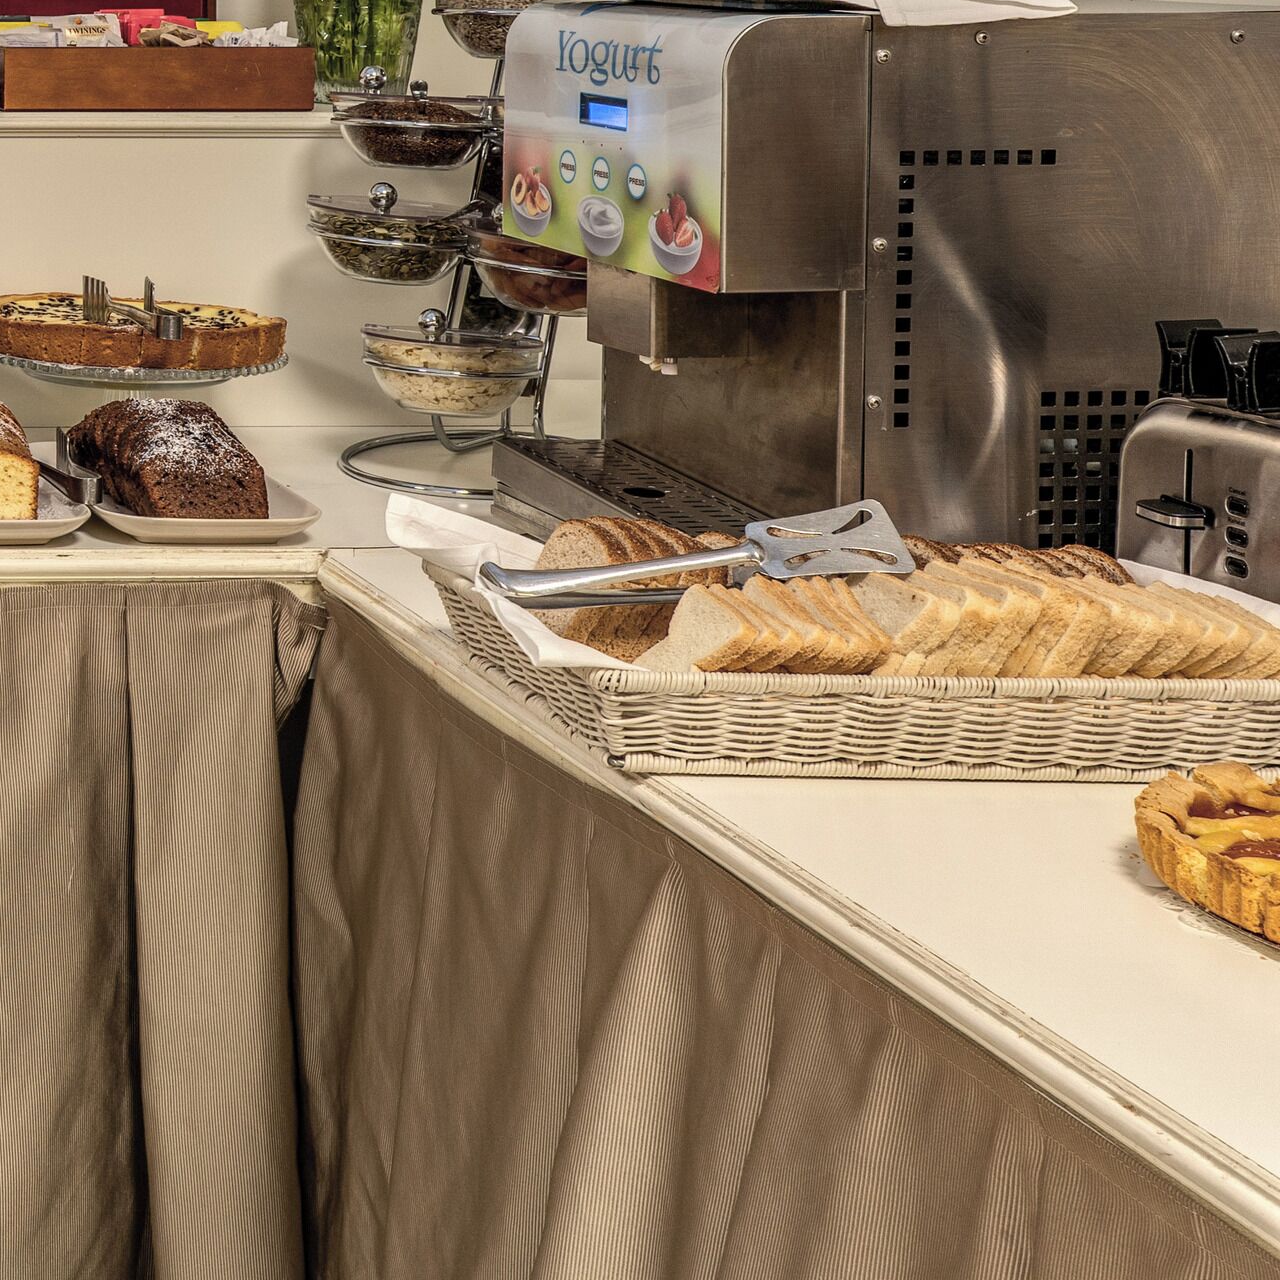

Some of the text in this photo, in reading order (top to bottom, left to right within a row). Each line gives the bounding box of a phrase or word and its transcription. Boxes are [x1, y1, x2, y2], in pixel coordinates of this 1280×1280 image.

[68, 26, 106, 34] TWININGS
[555, 30, 663, 86] Yogurt
[561, 162, 575, 172] PRESS
[594, 169, 609, 179] PRESS
[629, 177, 645, 187] PRESS
